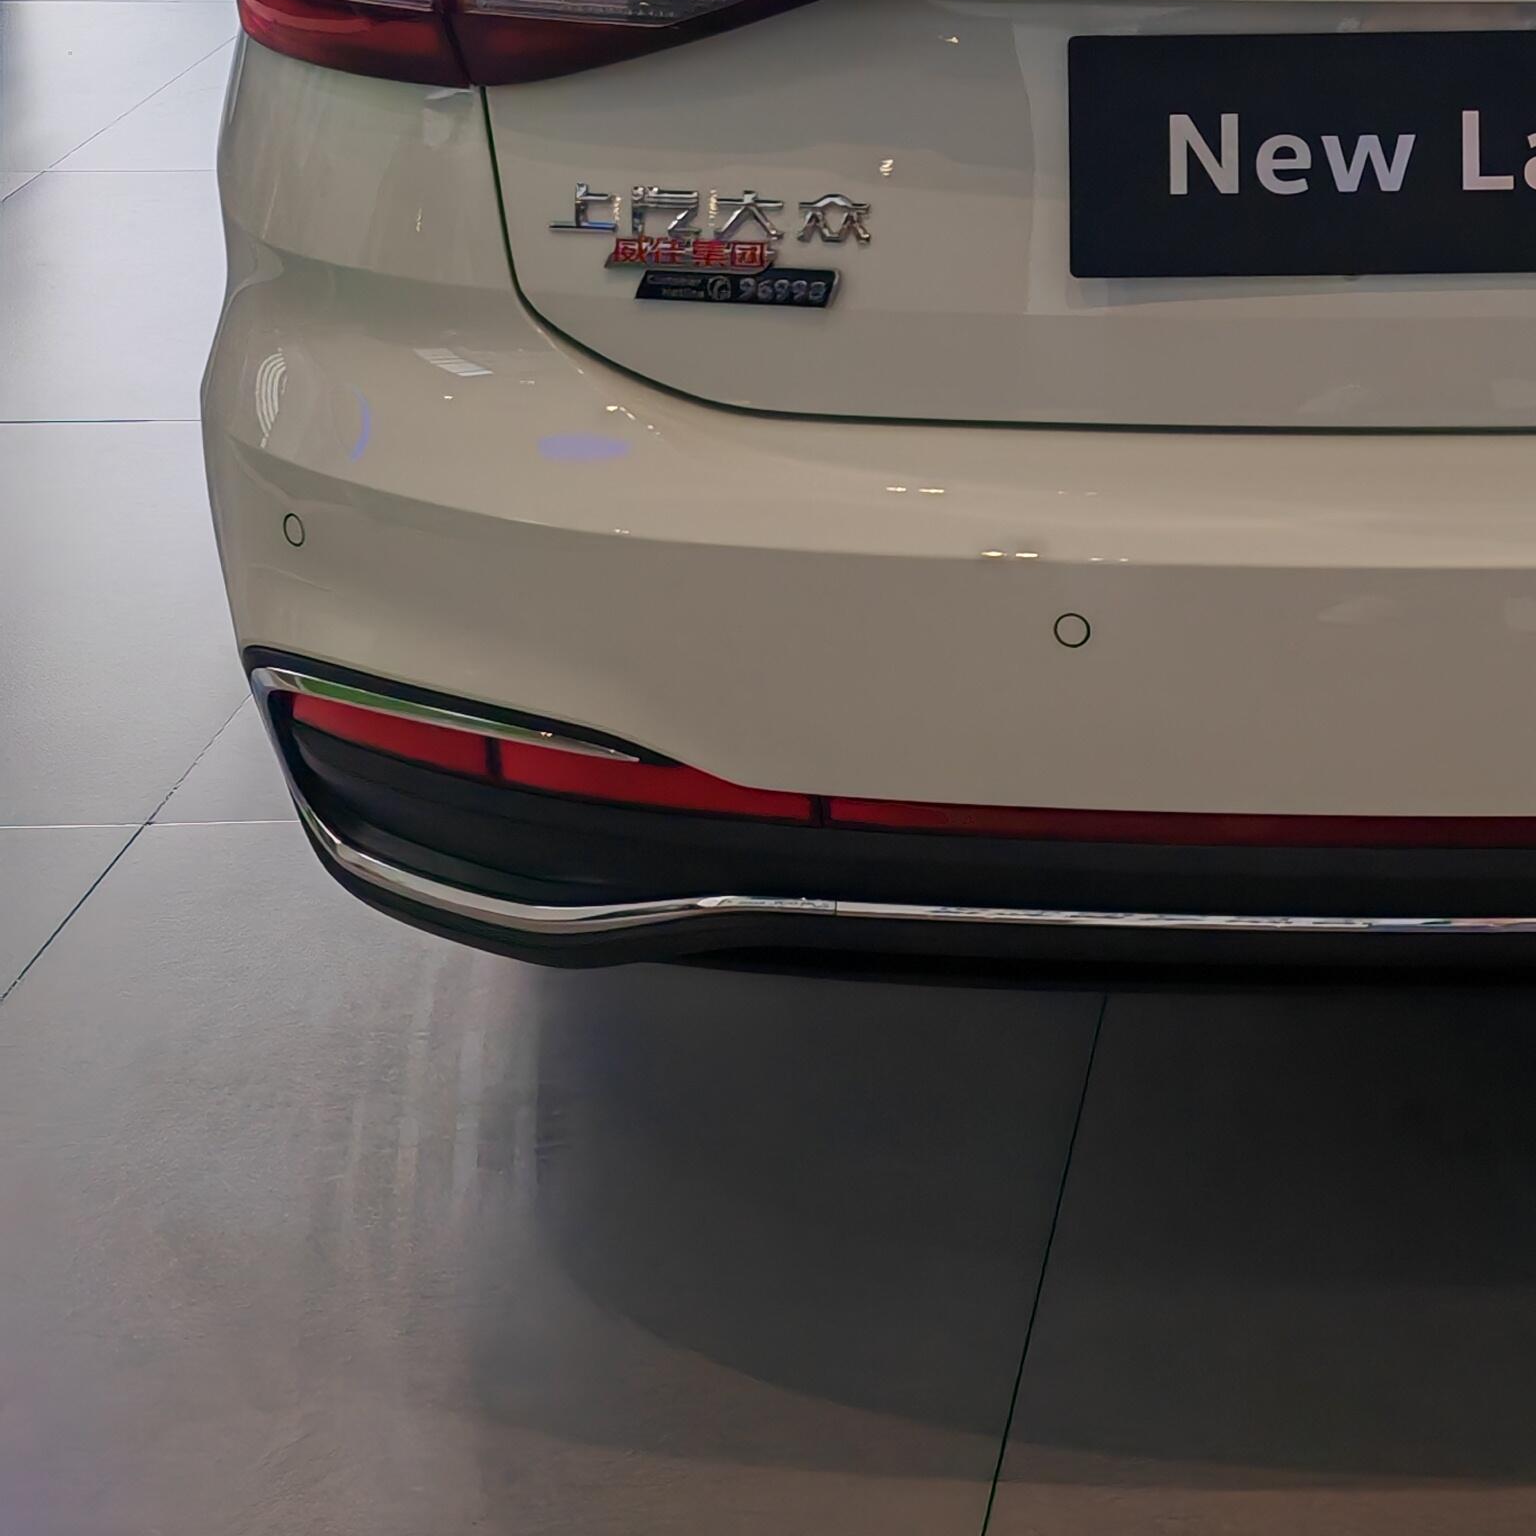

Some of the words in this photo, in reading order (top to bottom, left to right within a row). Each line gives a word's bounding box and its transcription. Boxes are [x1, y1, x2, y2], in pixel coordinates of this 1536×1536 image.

[1167, 112, 1417, 197] New
[548, 181, 872, 245] 上汽大众
